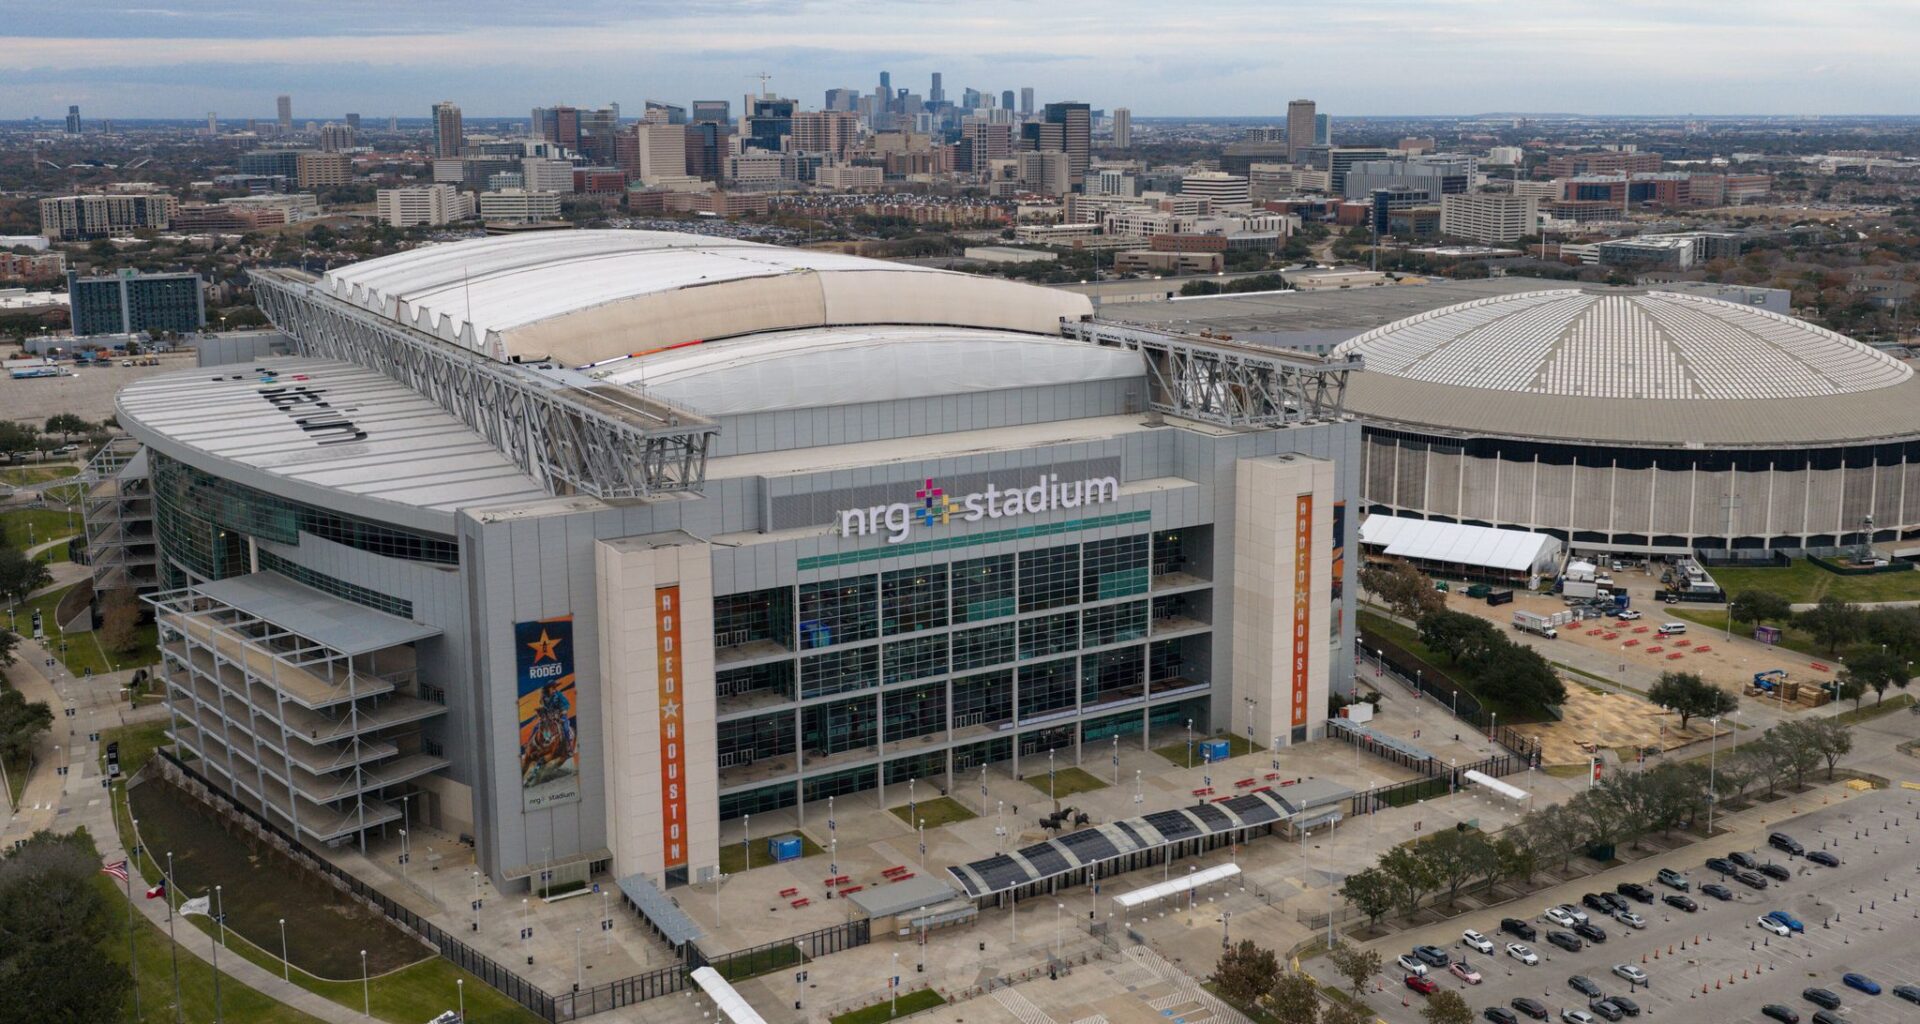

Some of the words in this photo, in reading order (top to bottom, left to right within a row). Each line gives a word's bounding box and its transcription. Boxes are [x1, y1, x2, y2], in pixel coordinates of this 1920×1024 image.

[842, 502, 910, 544] nrg
[963, 473, 1119, 522] stadium
[1298, 502, 1306, 582] RODEO
[530, 665, 562, 679] RODEO
[662, 595, 675, 693] RODEO
[1295, 607, 1304, 720] HOUSTON
[667, 722, 680, 860] HOUSTON
